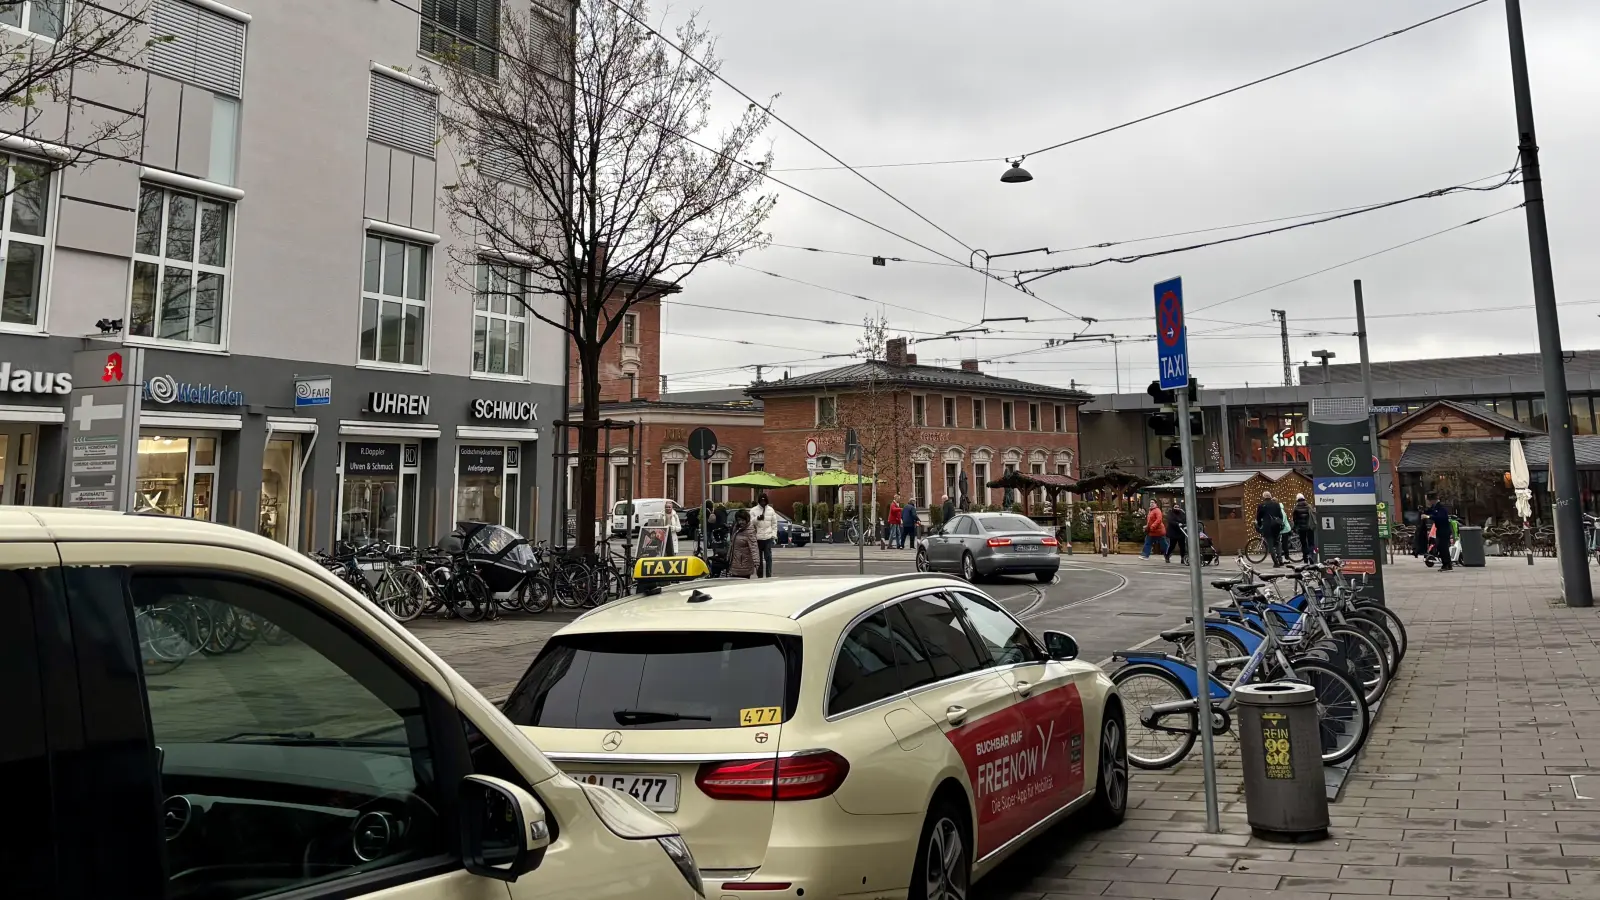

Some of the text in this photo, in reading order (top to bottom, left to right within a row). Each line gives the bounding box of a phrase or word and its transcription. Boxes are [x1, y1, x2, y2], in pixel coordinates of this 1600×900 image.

[1161, 354, 1185, 379] TAXI
[176, 383, 243, 406] Weltladen
[312, 388, 330, 398] FAIR
[373, 392, 430, 416] UHREN
[475, 399, 538, 421] SCHMUCK
[349, 462, 394, 470] Uhren & Schmuck
[643, 560, 686, 575] TAXI
[744, 708, 777, 723] 477
[976, 730, 1023, 756] BUCHBAR AUF
[1263, 728, 1289, 739] REIN
[628, 778, 668, 802] 477
